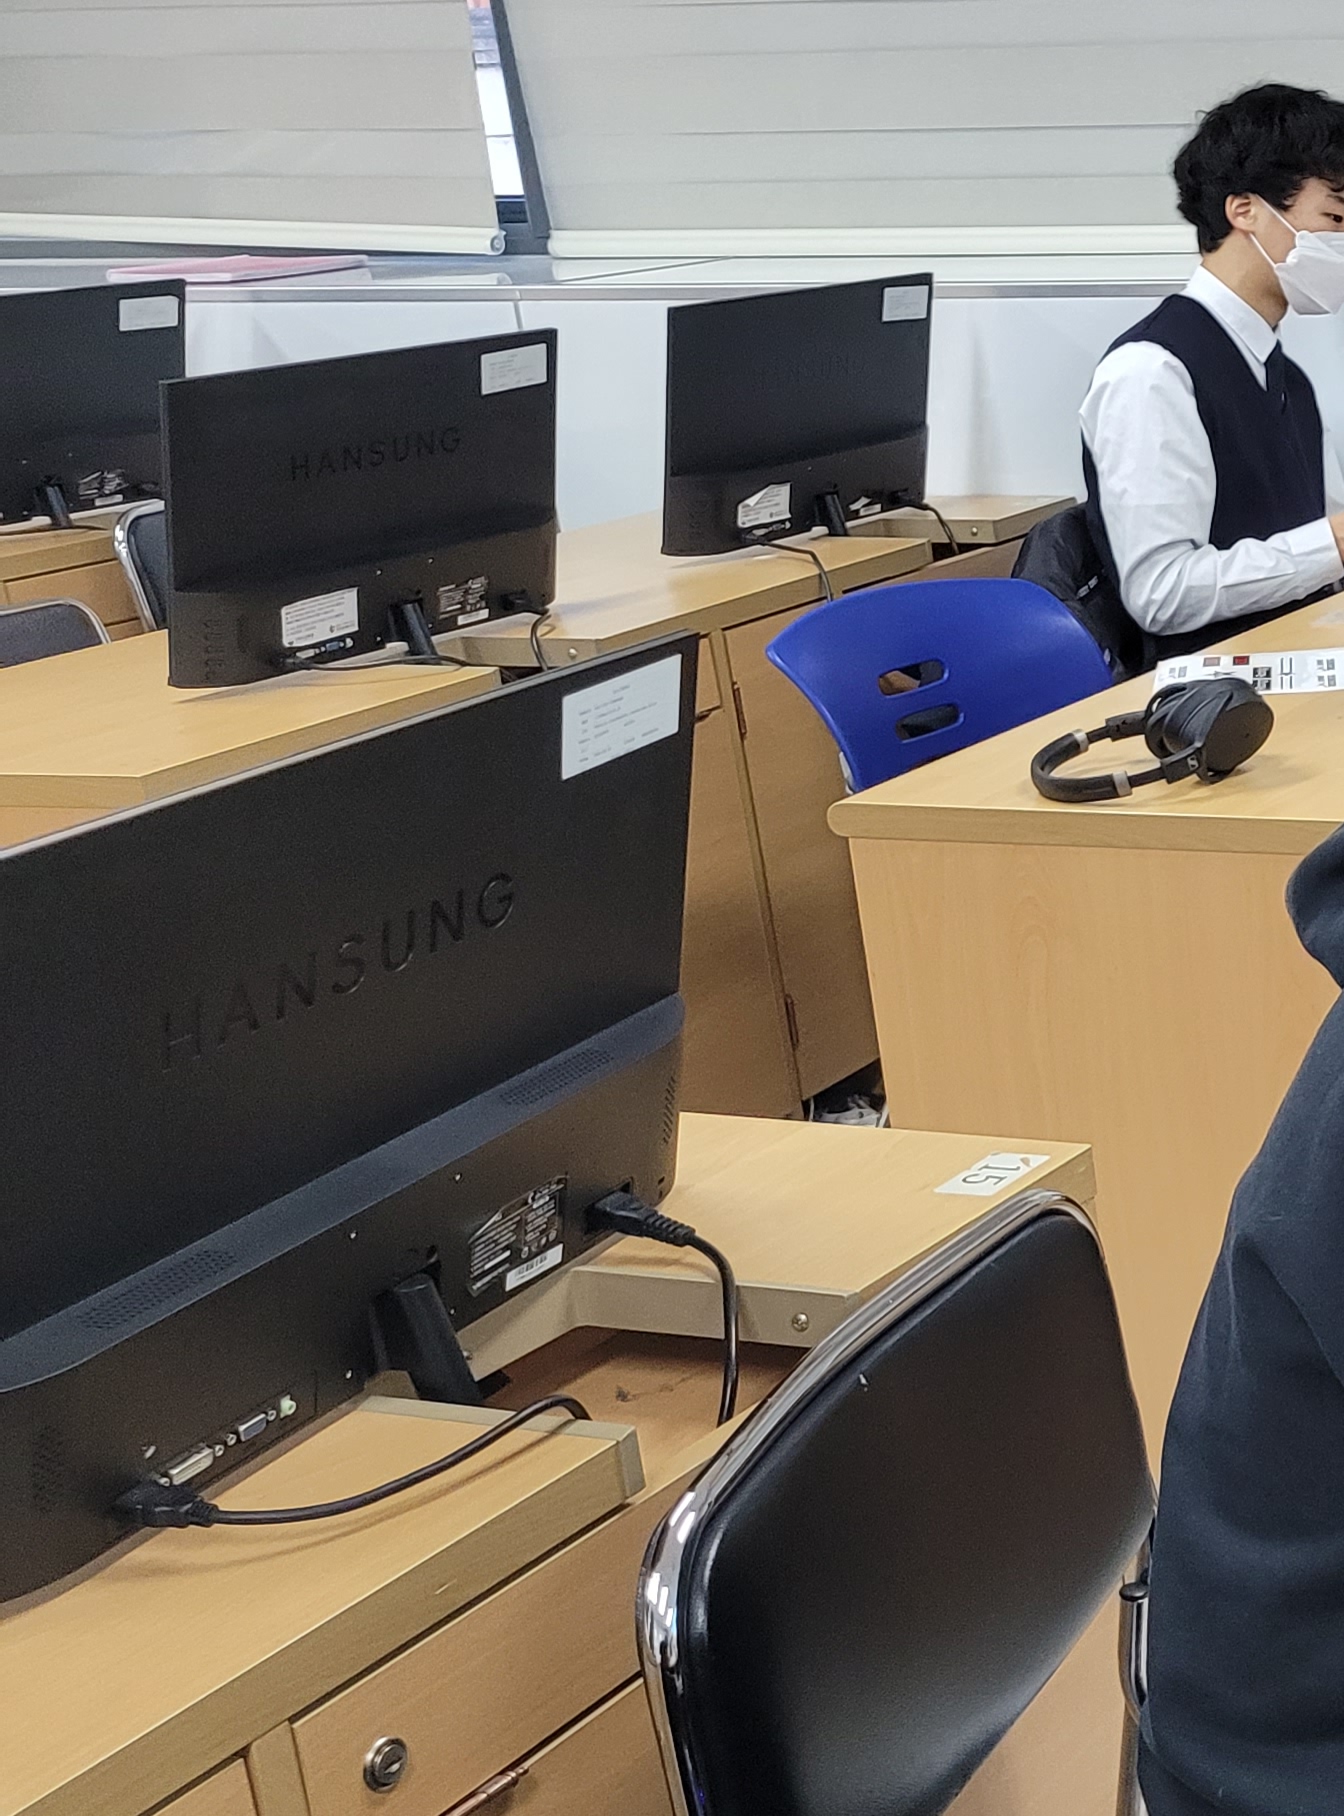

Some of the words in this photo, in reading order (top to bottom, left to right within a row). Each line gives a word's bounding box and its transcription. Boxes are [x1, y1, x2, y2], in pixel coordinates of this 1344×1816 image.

[289, 427, 463, 482] HANSUNG
[161, 871, 516, 1074] HANSUNG
[961, 1162, 1021, 1187] 15
